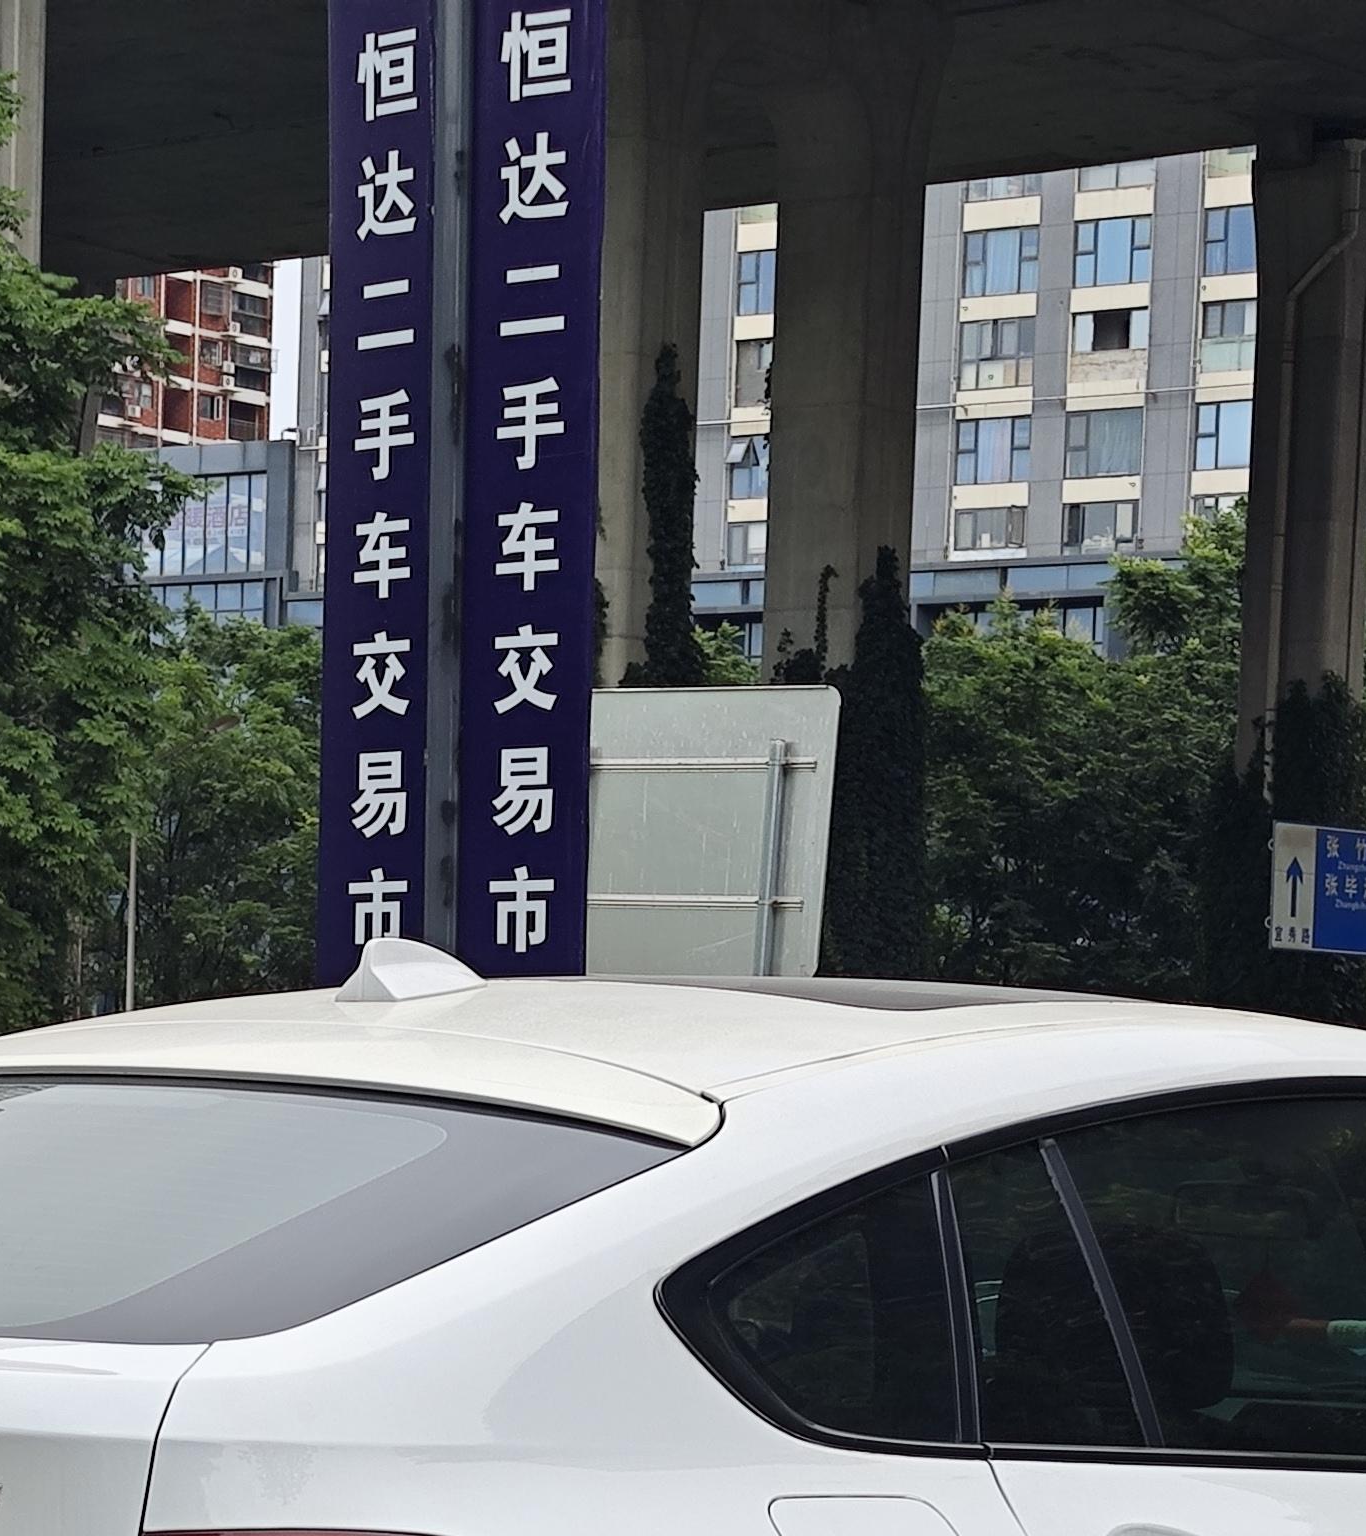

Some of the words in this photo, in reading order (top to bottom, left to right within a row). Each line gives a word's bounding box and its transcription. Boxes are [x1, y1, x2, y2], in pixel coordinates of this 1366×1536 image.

[348, 28, 418, 945] 恒达二手车交易市
[489, 8, 572, 953] 恒达二手车交易市
